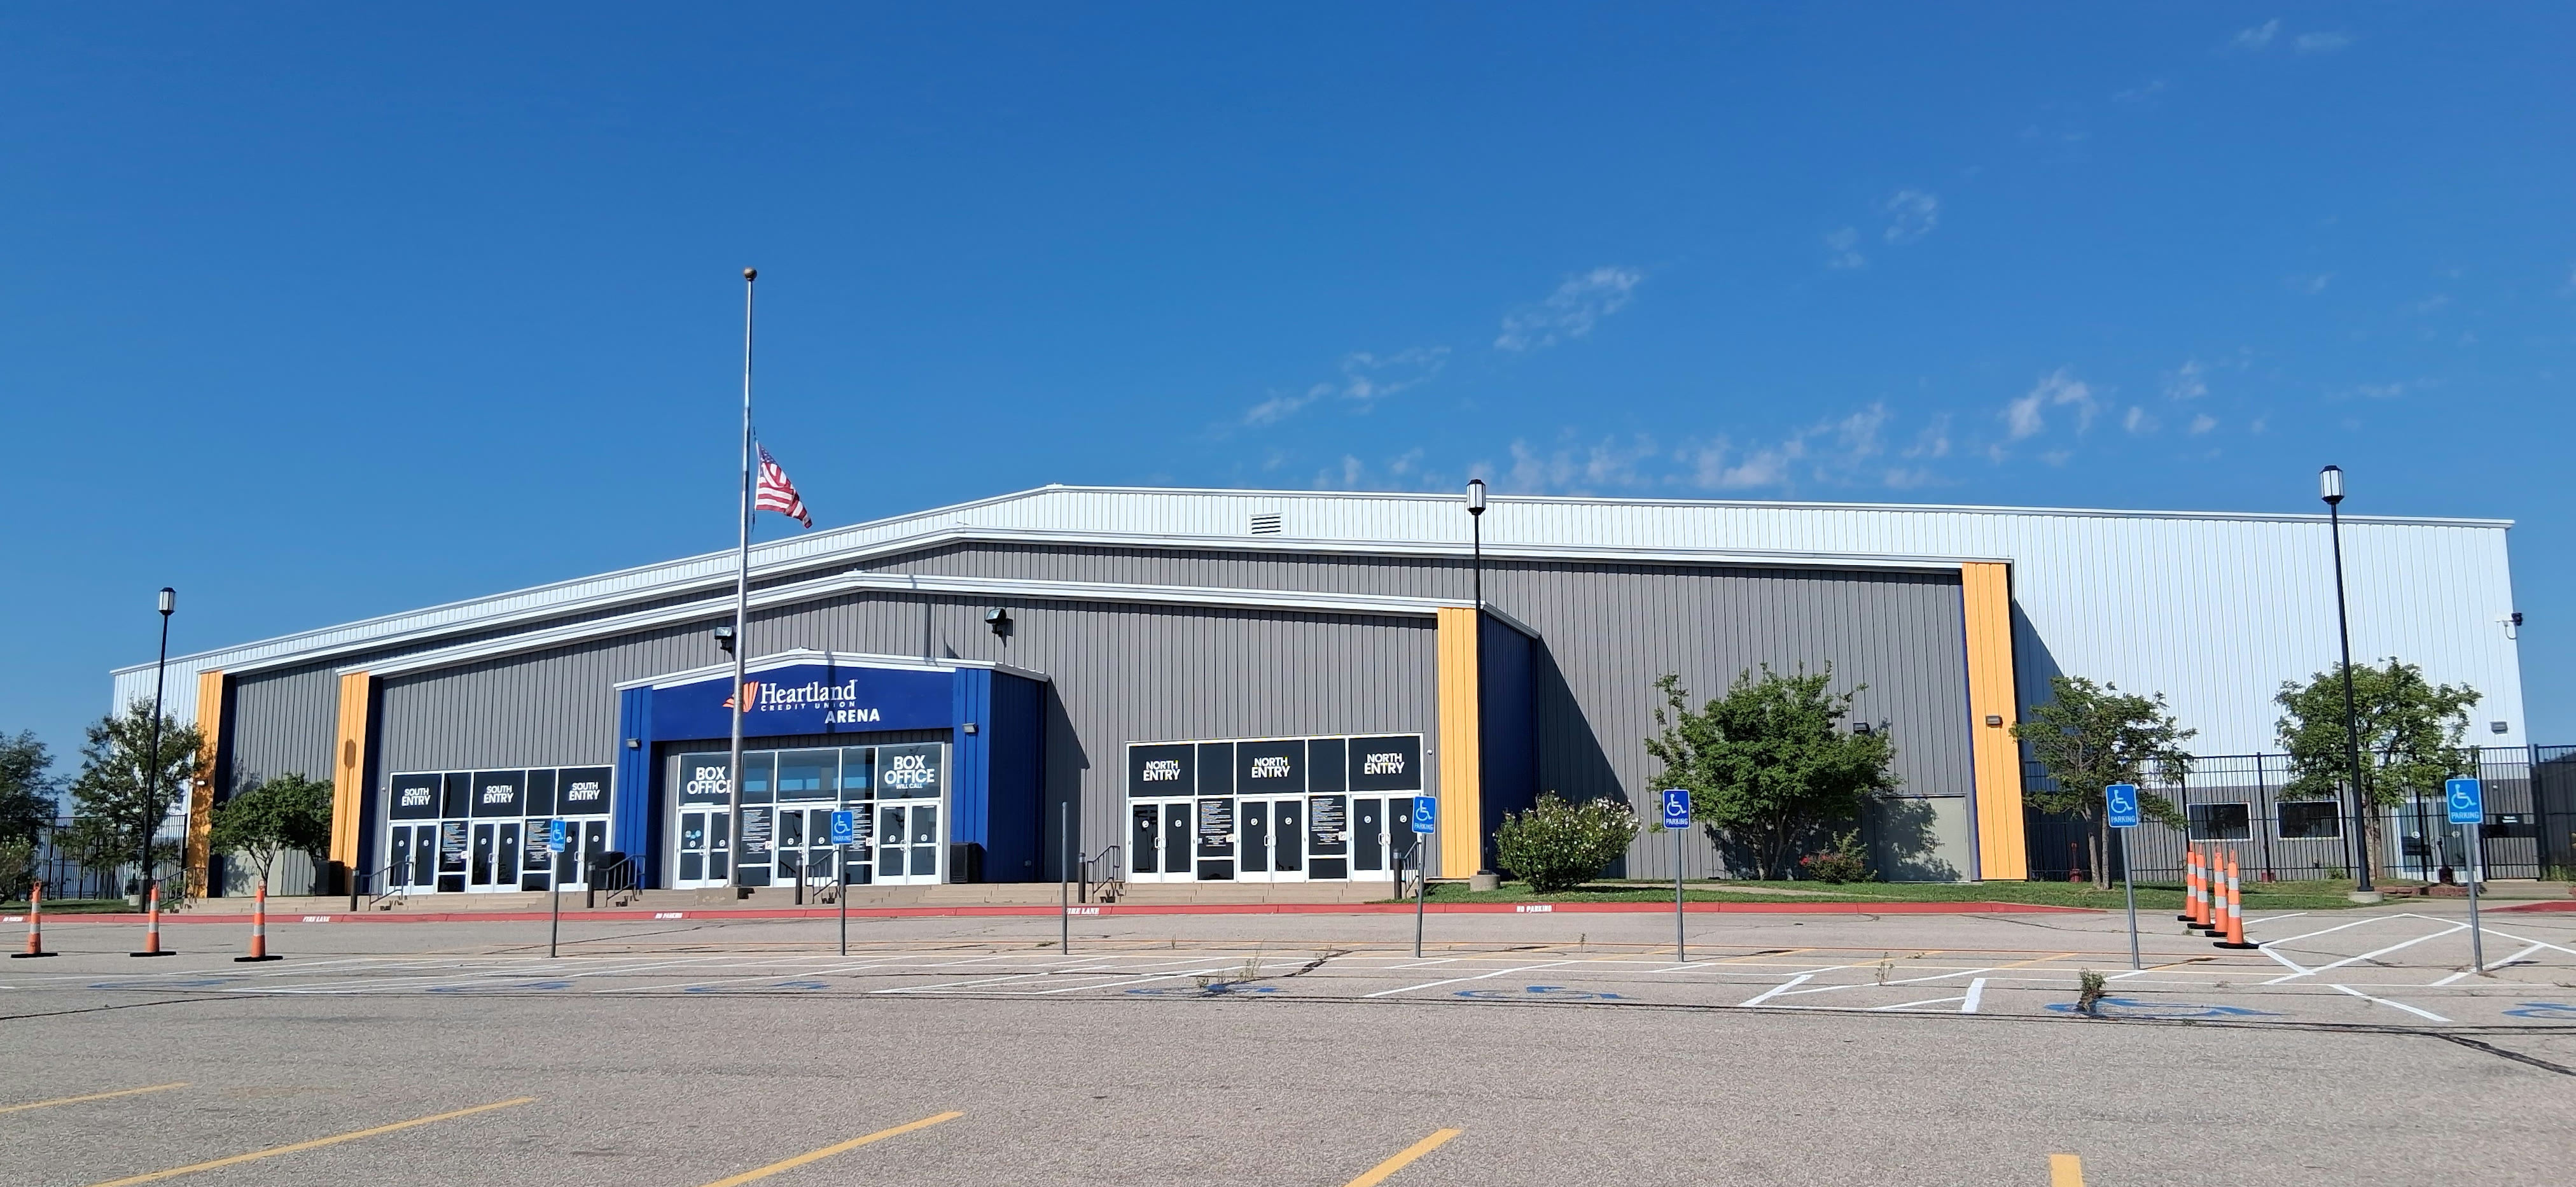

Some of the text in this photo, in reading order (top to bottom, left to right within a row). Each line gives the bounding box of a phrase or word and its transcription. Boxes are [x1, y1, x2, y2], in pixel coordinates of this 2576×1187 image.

[760, 679, 856, 705] Heartland
[760, 701, 855, 712] CREDIT UNION
[825, 708, 880, 724] ARENA
[893, 755, 926, 770] BOX
[1254, 757, 1288, 767] NORTH
[1367, 753, 1402, 763] NORTH
[1146, 760, 1179, 770] NORTH
[1364, 762, 1405, 775] ENTRY
[695, 766, 726, 781] BOX
[884, 768, 935, 785] OFFICE
[1143, 769, 1181, 782] ENTRY
[1251, 766, 1291, 778] ENTRY
[404, 787, 429, 796] SOUTH
[486, 785, 512, 794] SOUTH
[572, 782, 599, 790] SOUTH
[401, 795, 431, 806] ENTRY
[484, 792, 514, 803] ENTRY
[569, 789, 601, 801] ENTRY
